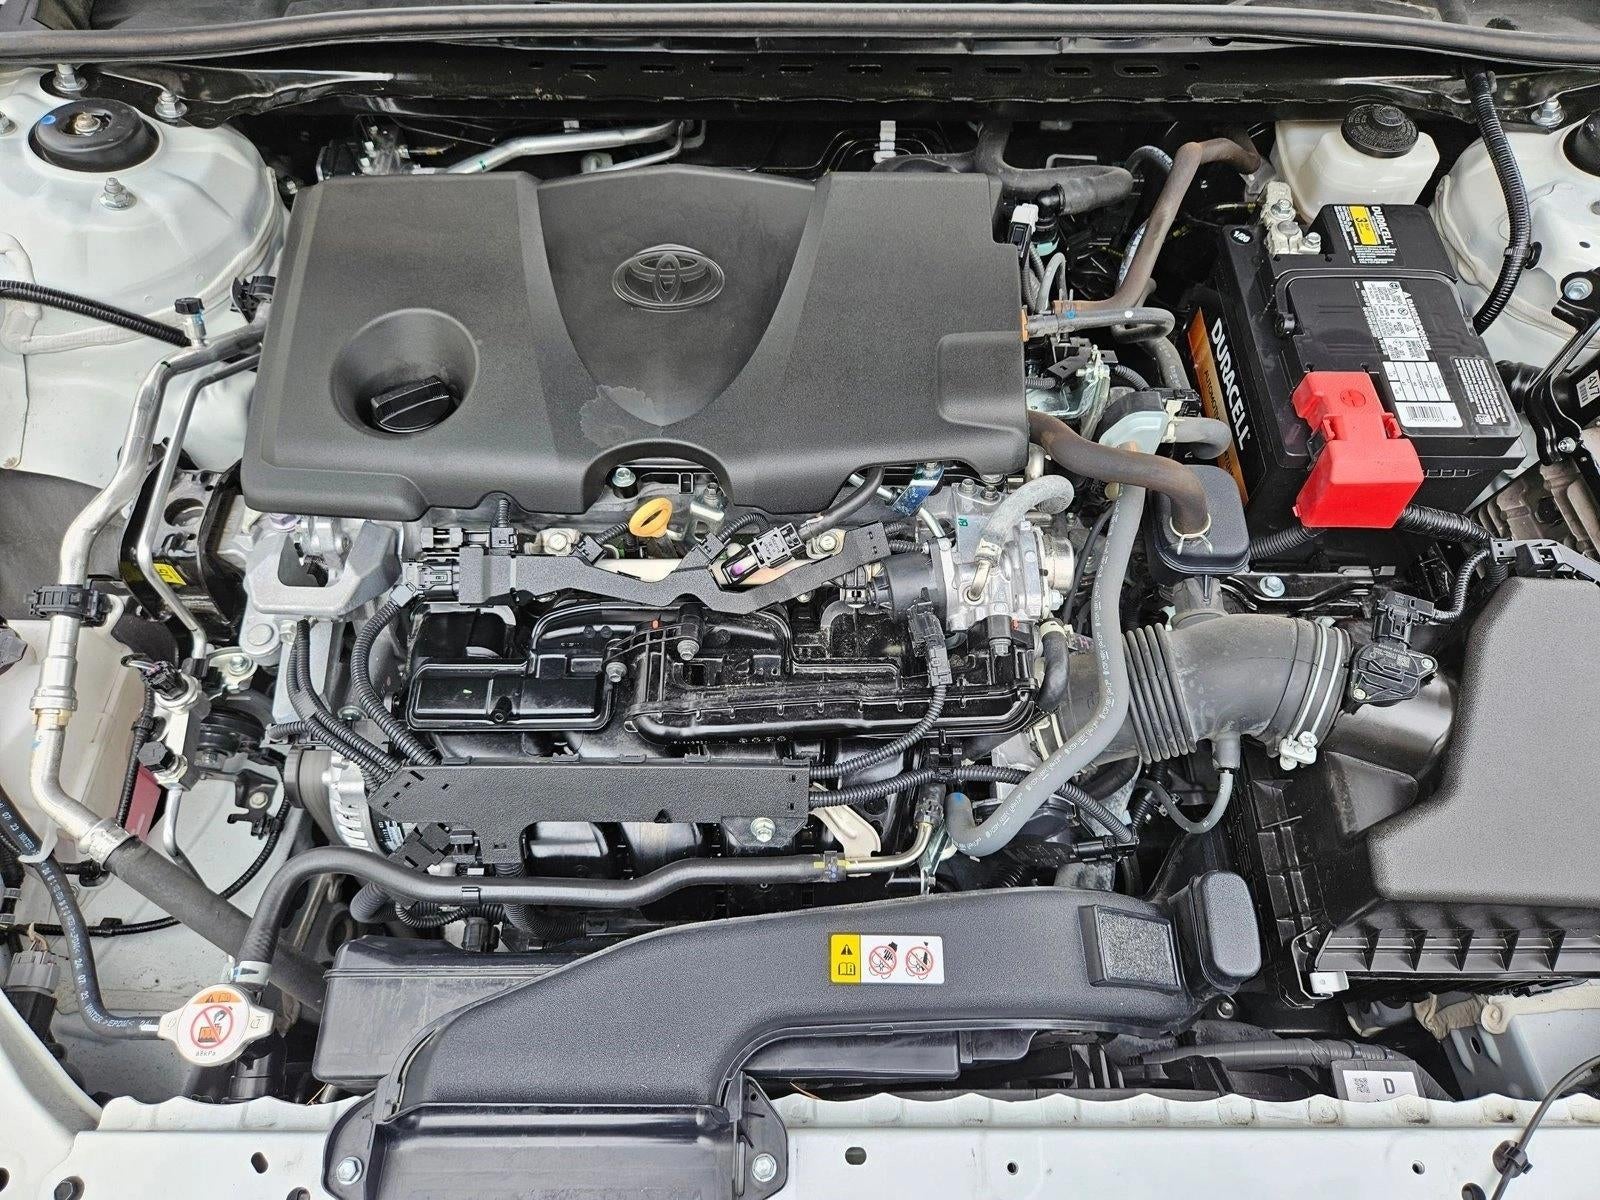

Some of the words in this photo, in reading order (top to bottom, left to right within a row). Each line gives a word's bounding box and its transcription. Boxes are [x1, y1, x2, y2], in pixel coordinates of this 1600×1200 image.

[1371, 206, 1394, 244] DURACELL
[1211, 317, 1248, 451] DURACELL
[1382, 1077, 1396, 1095] D
